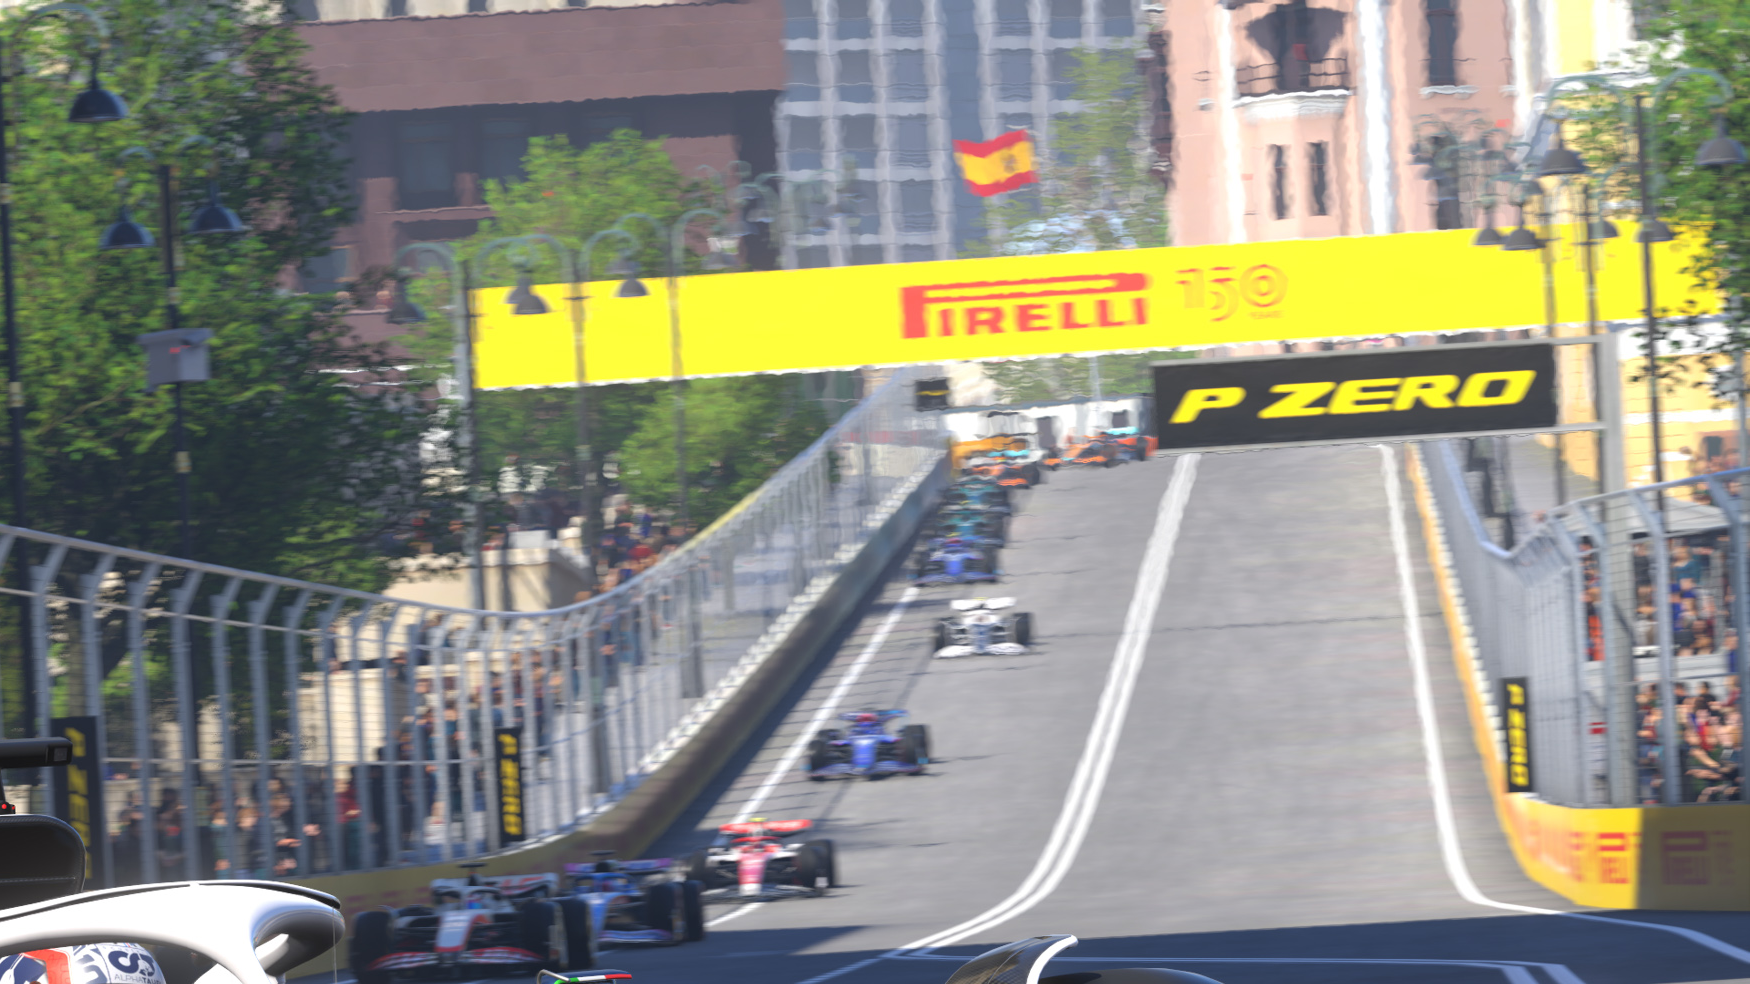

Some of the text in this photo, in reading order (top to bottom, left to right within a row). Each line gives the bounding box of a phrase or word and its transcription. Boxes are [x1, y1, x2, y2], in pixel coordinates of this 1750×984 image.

[900, 273, 1151, 339] PIRELLI
[1168, 370, 1537, 424] P ZERO
[67, 764, 92, 879] ZER
